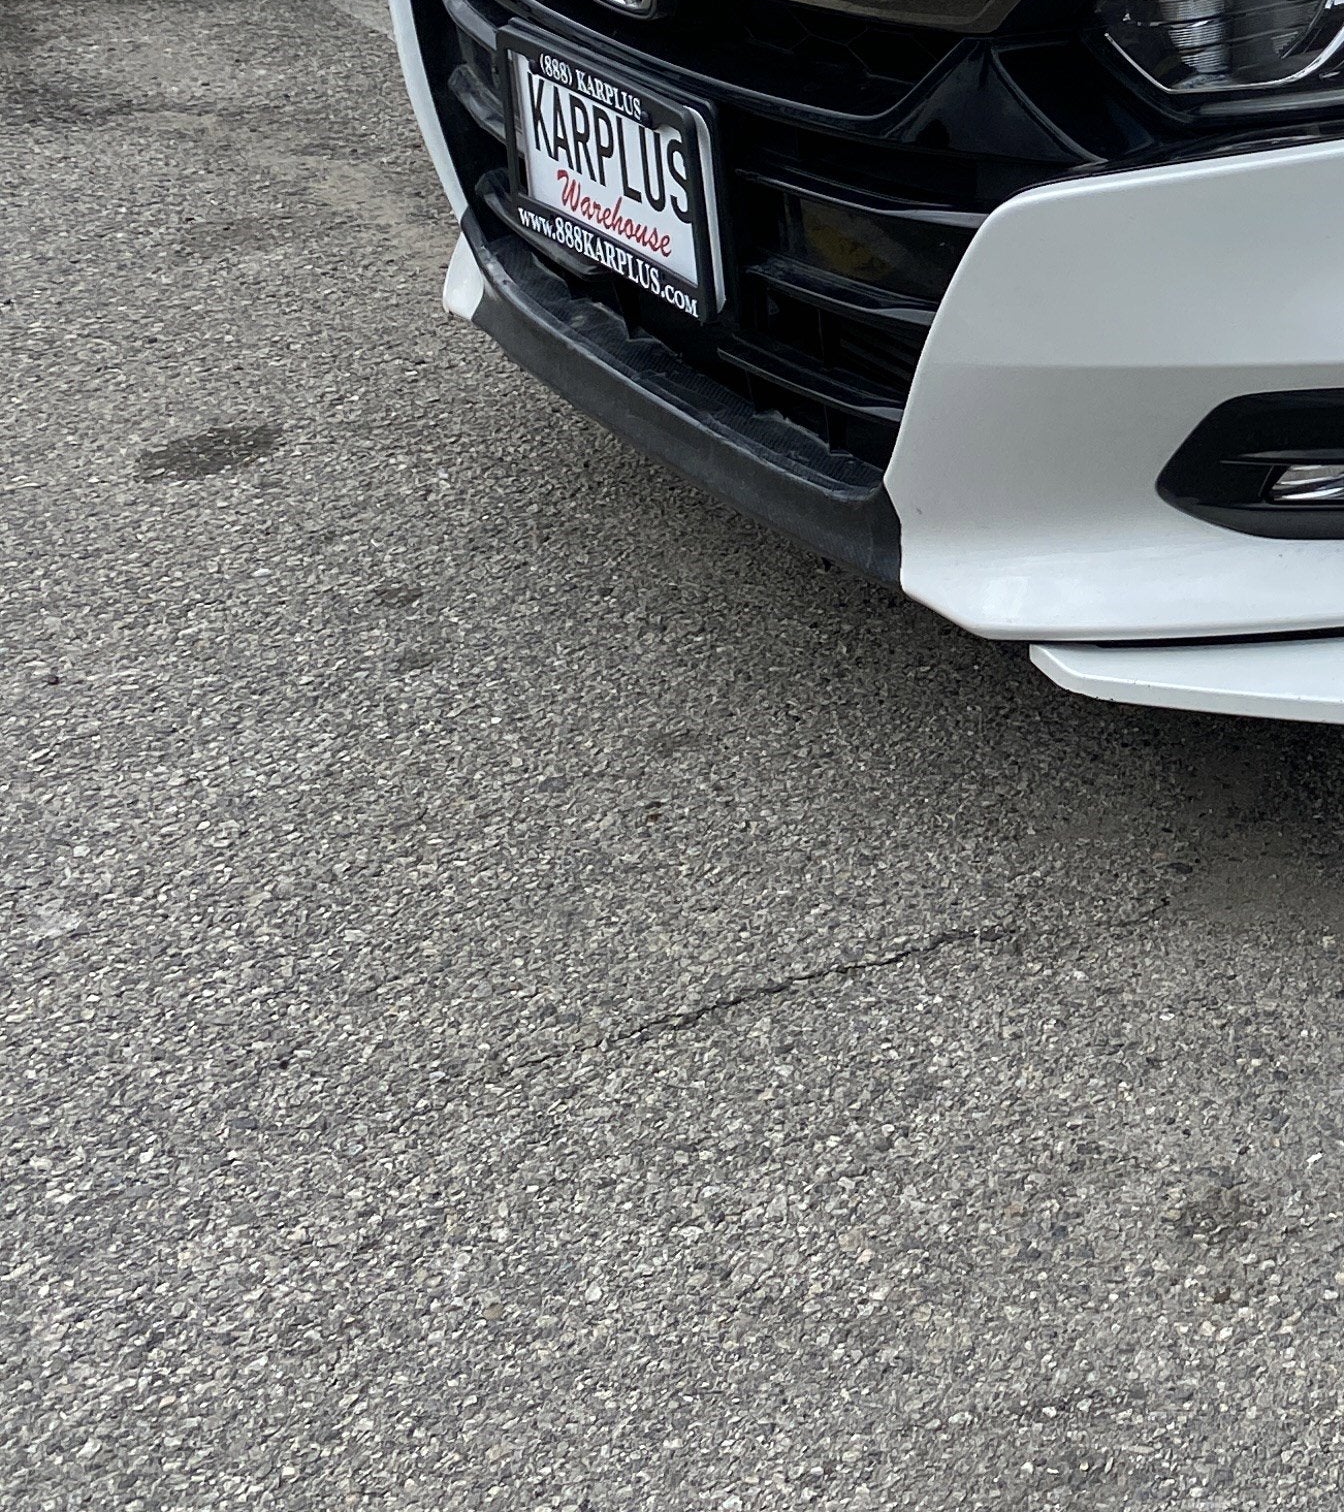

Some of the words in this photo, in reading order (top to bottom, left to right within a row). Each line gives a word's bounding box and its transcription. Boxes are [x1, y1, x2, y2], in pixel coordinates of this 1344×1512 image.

[540, 53, 573, 85] (888)
[575, 69, 643, 120] KARPLUS
[526, 71, 693, 224] KARPLUS
[557, 169, 672, 258] Warehouse
